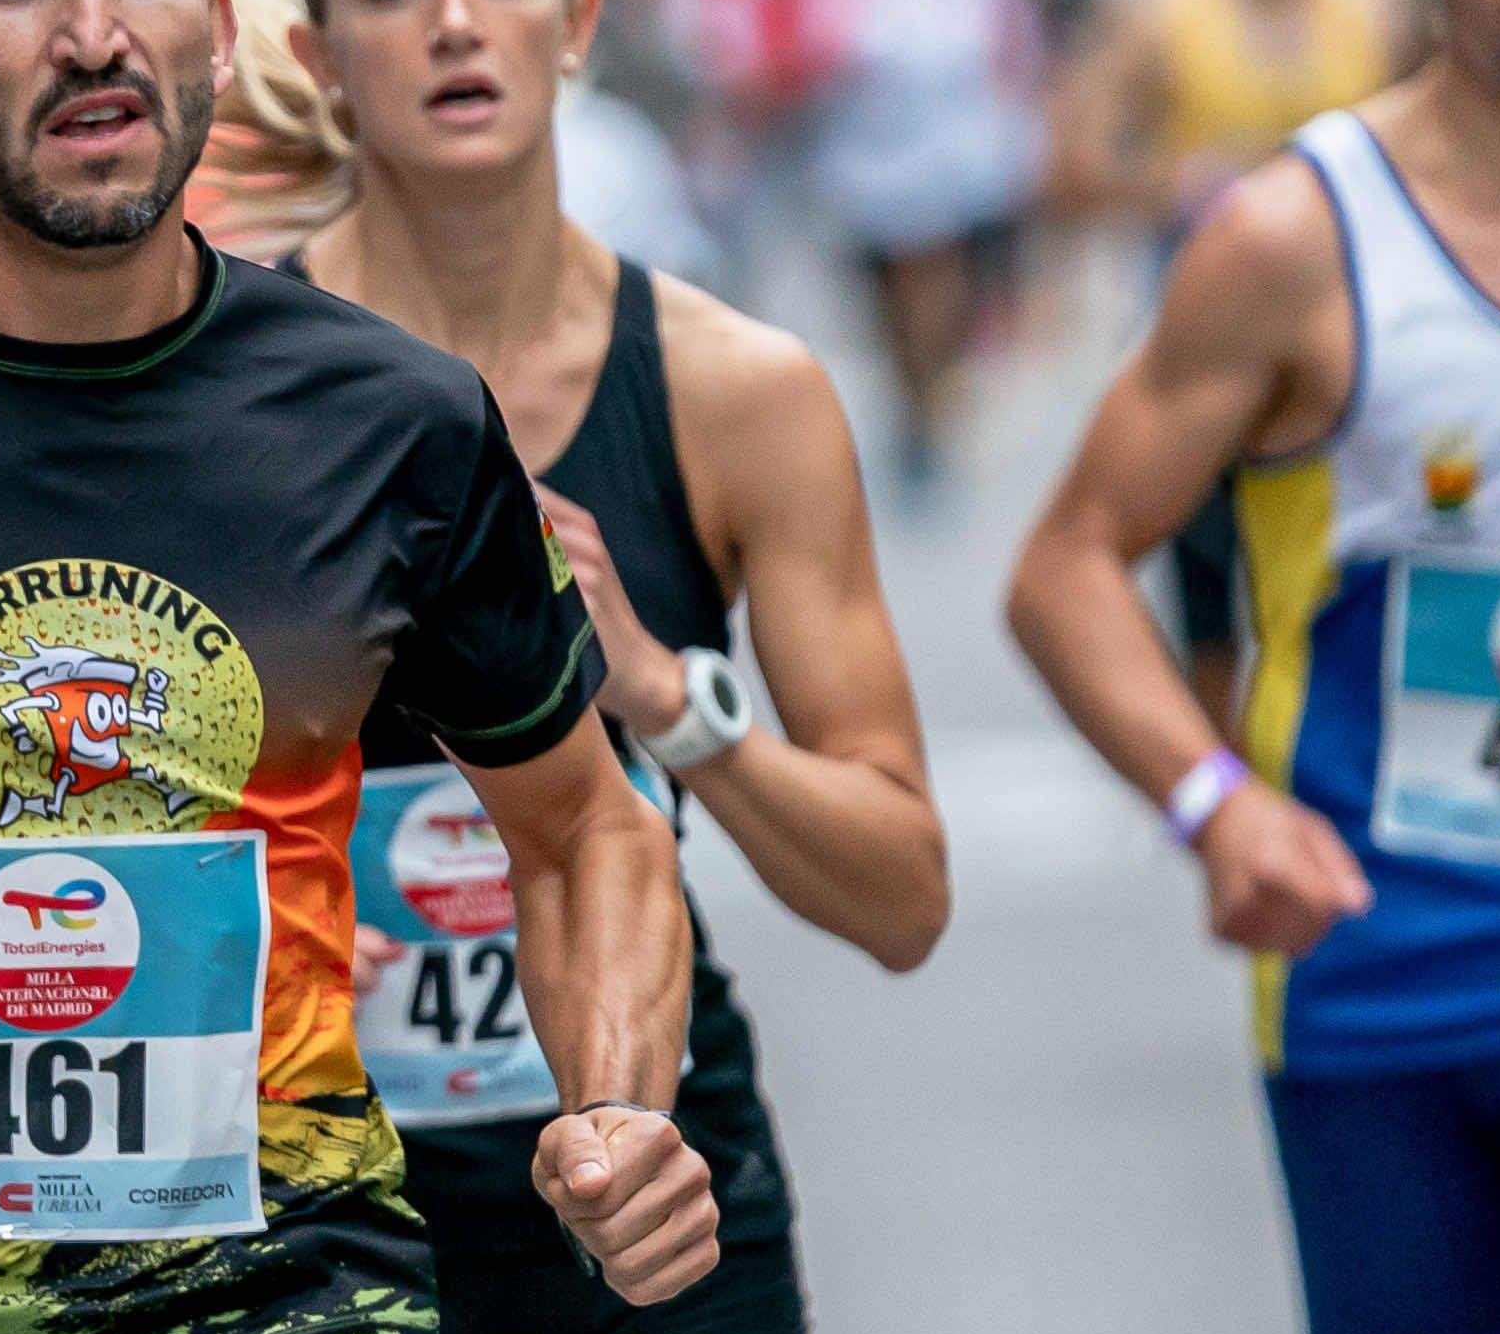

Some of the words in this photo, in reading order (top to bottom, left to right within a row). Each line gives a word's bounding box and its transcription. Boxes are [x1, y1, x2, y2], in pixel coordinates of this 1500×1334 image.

[2, 940, 106, 957] TotalEnergies
[26, 971, 75, 985] MILLA
[410, 946, 523, 1044] 42
[6, 1003, 29, 1017] DE
[30, 1002, 93, 1017] MADRID
[38, 1182, 95, 1196] MILLA
